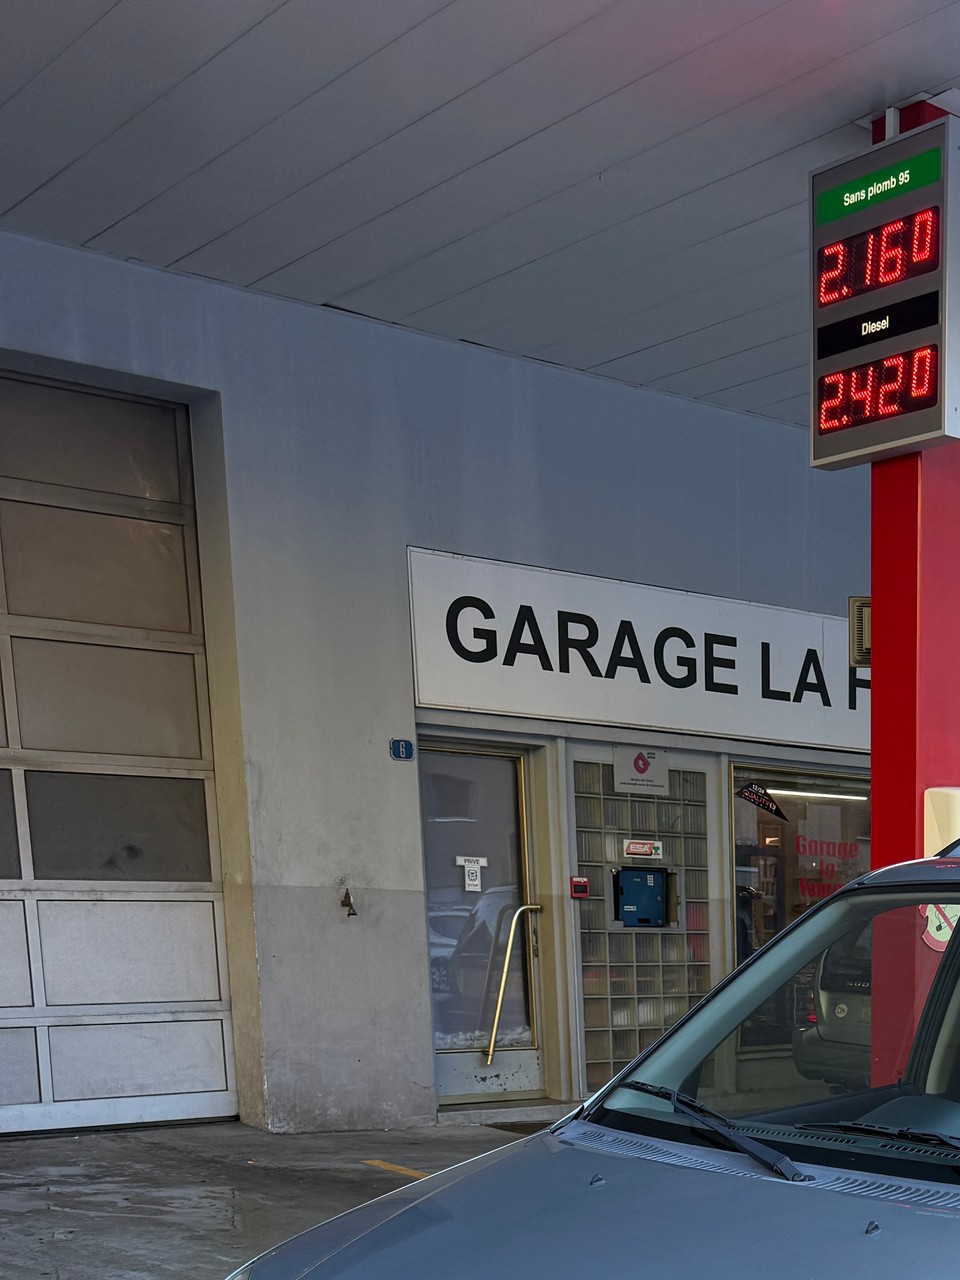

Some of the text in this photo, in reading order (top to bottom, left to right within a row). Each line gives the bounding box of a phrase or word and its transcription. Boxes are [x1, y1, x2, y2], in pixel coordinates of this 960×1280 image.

[843, 169, 910, 206] Sans plomb 95
[819, 209, 933, 304] 2.160
[861, 315, 889, 336] Diesel
[819, 348, 932, 430] 2.420
[445, 596, 738, 695] GARAGE
[761, 641, 832, 707] LA
[400, 741, 406, 757] 6
[795, 834, 859, 859] Garage
